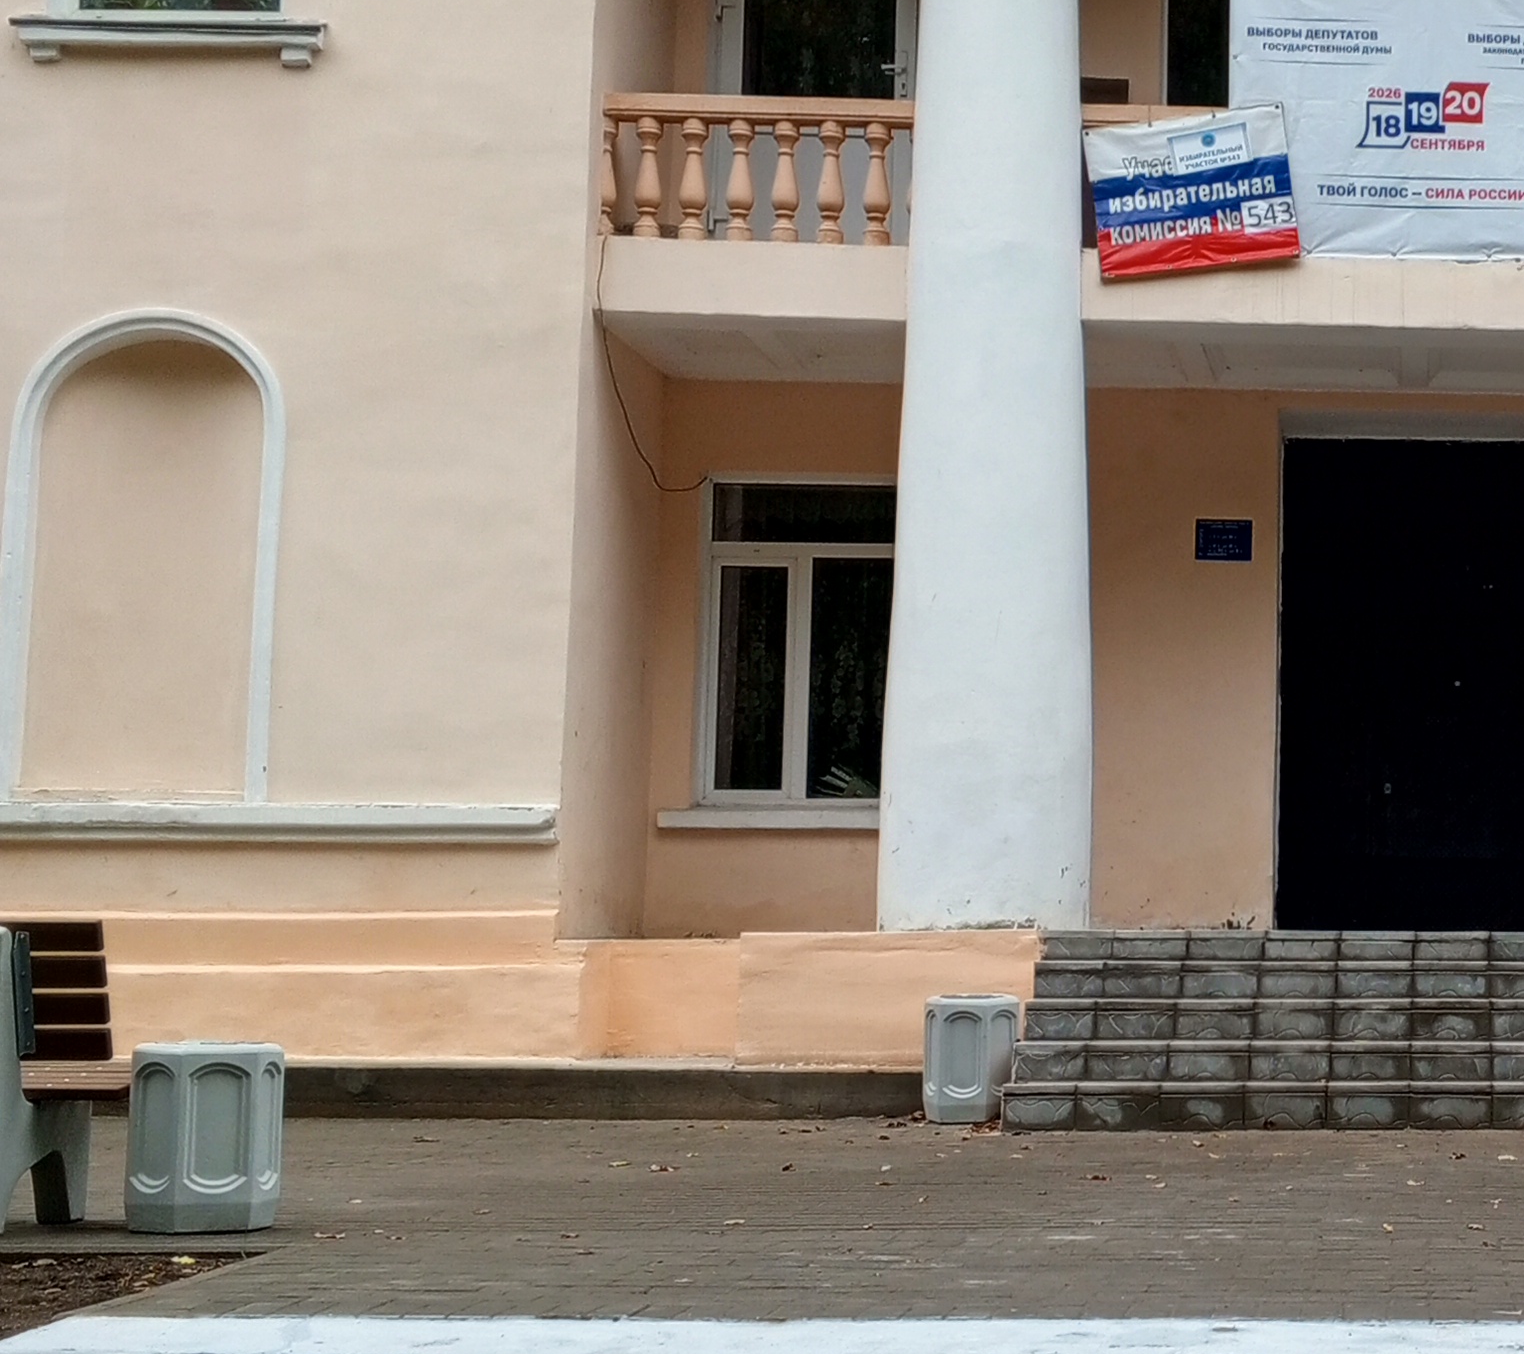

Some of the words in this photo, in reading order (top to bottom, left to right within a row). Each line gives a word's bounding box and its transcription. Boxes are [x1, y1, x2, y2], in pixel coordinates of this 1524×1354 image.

[1247, 27, 1302, 38] ВЫБОРЫ
[1304, 29, 1379, 41] ДЕПУТАТОВ
[1467, 33, 1521, 44] ВЫБОРЫ
[1262, 42, 1360, 54] ГОСУДАРСТВЕННОЙ
[1361, 45, 1393, 55] ДУМЫ
[1368, 87, 1402, 99] 2026
[1444, 90, 1481, 116] 20
[1407, 101, 1438, 126] 19
[1372, 114, 1401, 138] 18
[1410, 138, 1485, 152] СЕНТЯБРЯ
[1109, 175, 1276, 215] избирательная
[1317, 182, 1357, 196] ТВОЙ
[1360, 186, 1409, 199] ГОЛОС
[1425, 187, 1465, 201] СИЛА
[1110, 216, 1212, 246] комиссия
